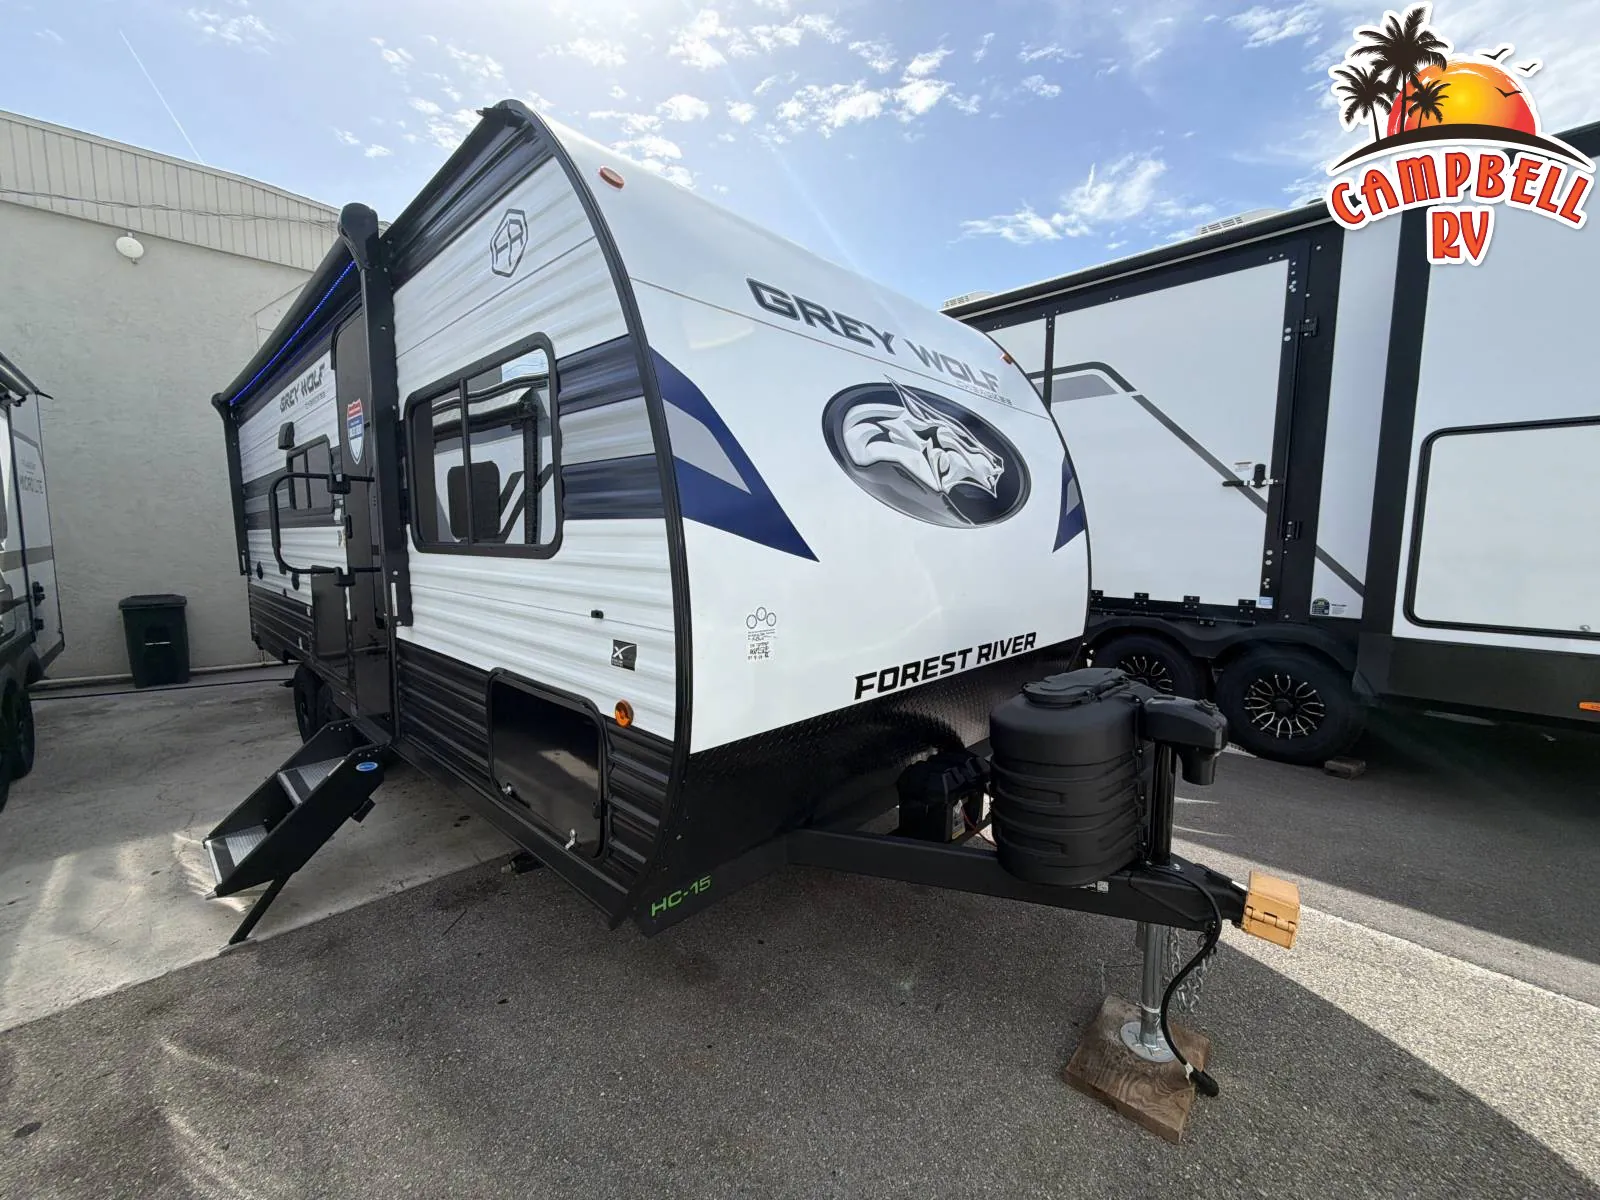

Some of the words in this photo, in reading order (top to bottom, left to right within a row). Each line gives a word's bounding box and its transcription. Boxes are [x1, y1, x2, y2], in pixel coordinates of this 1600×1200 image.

[745, 277, 897, 355] GREY
[903, 337, 1000, 393] WOLF
[280, 382, 300, 413] GREY
[300, 362, 325, 397] WOLF
[854, 647, 973, 700] FOREST
[976, 631, 1037, 664] RIVER
[651, 874, 711, 917] HC-15
